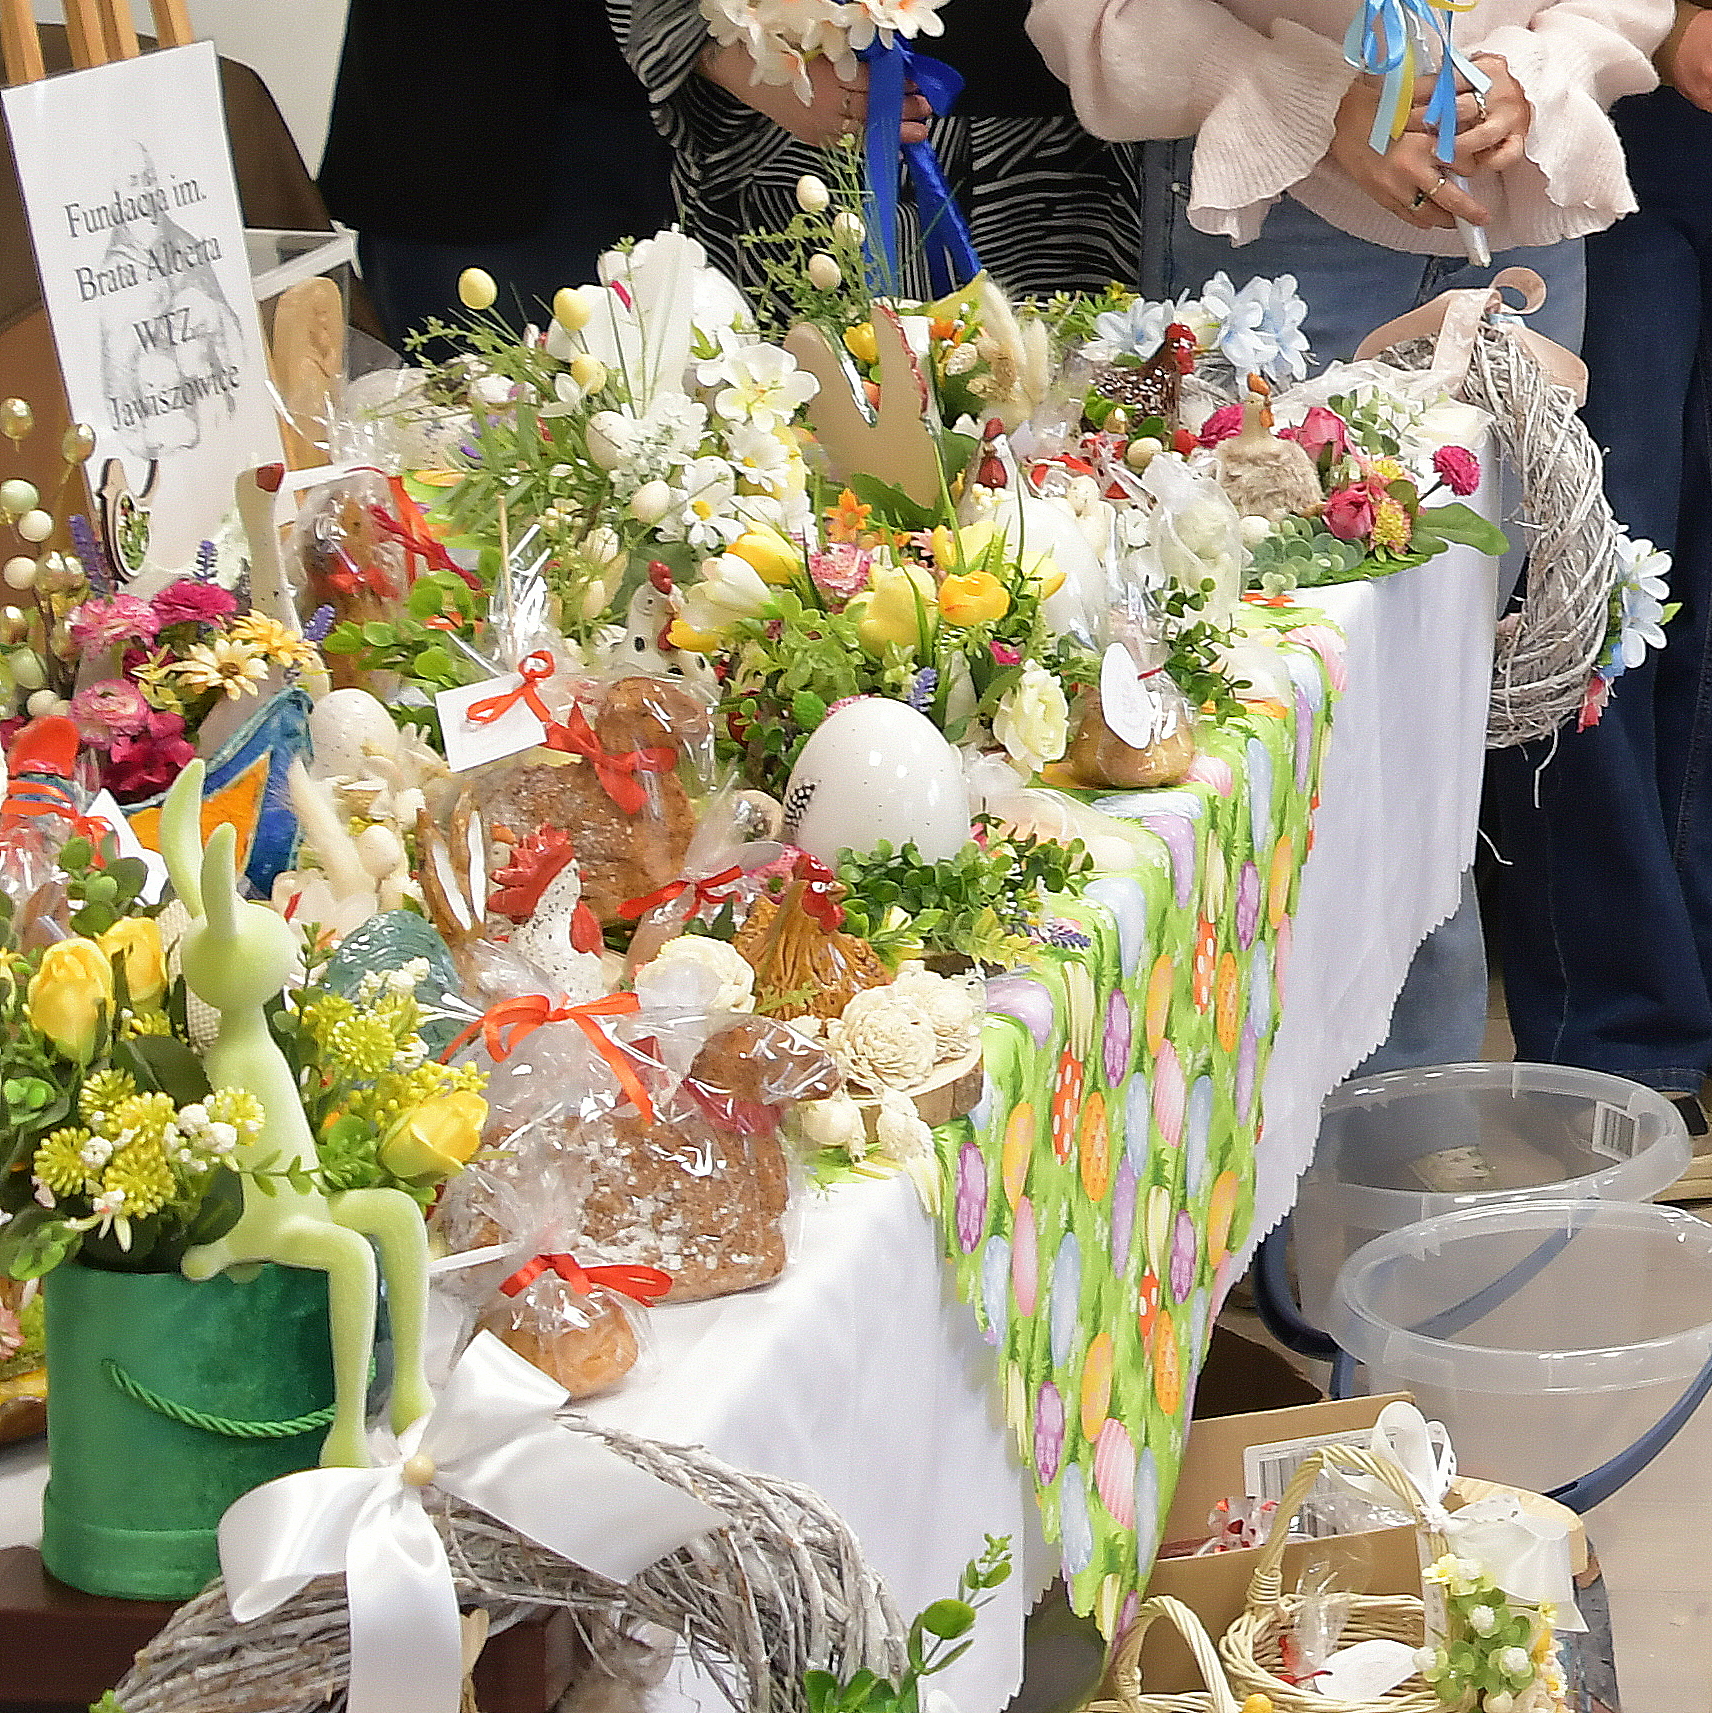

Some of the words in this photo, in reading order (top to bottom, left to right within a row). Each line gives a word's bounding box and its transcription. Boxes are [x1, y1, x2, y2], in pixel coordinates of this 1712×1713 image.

[64, 187, 170, 238] Fundacja
[171, 173, 208, 208] im.
[74, 264, 140, 303] Brata
[146, 236, 223, 282] Alberta
[132, 306, 198, 354] WTZ
[108, 363, 241, 432] Jawiszowice
